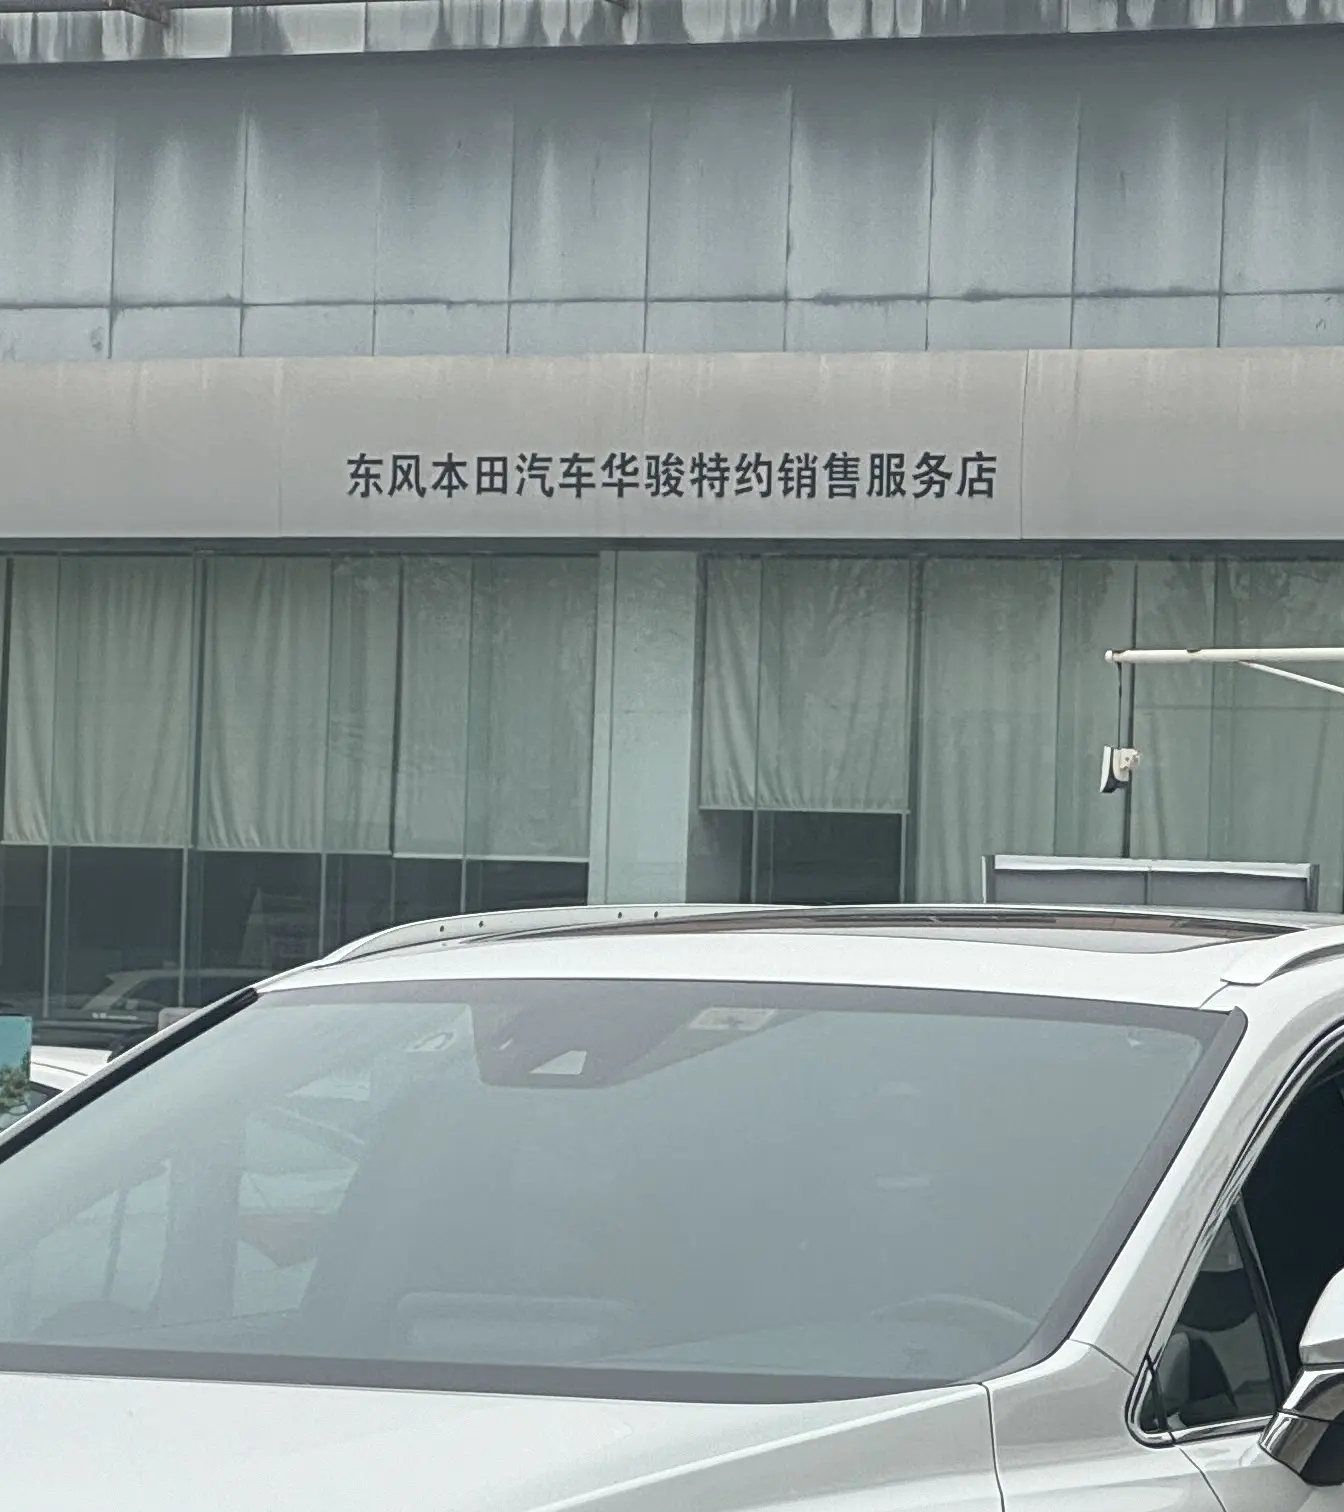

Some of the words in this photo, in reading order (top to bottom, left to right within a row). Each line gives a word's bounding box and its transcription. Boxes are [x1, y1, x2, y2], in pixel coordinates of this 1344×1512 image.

[346, 450, 999, 500] 东风本田汽车华骏特约销售服务店
